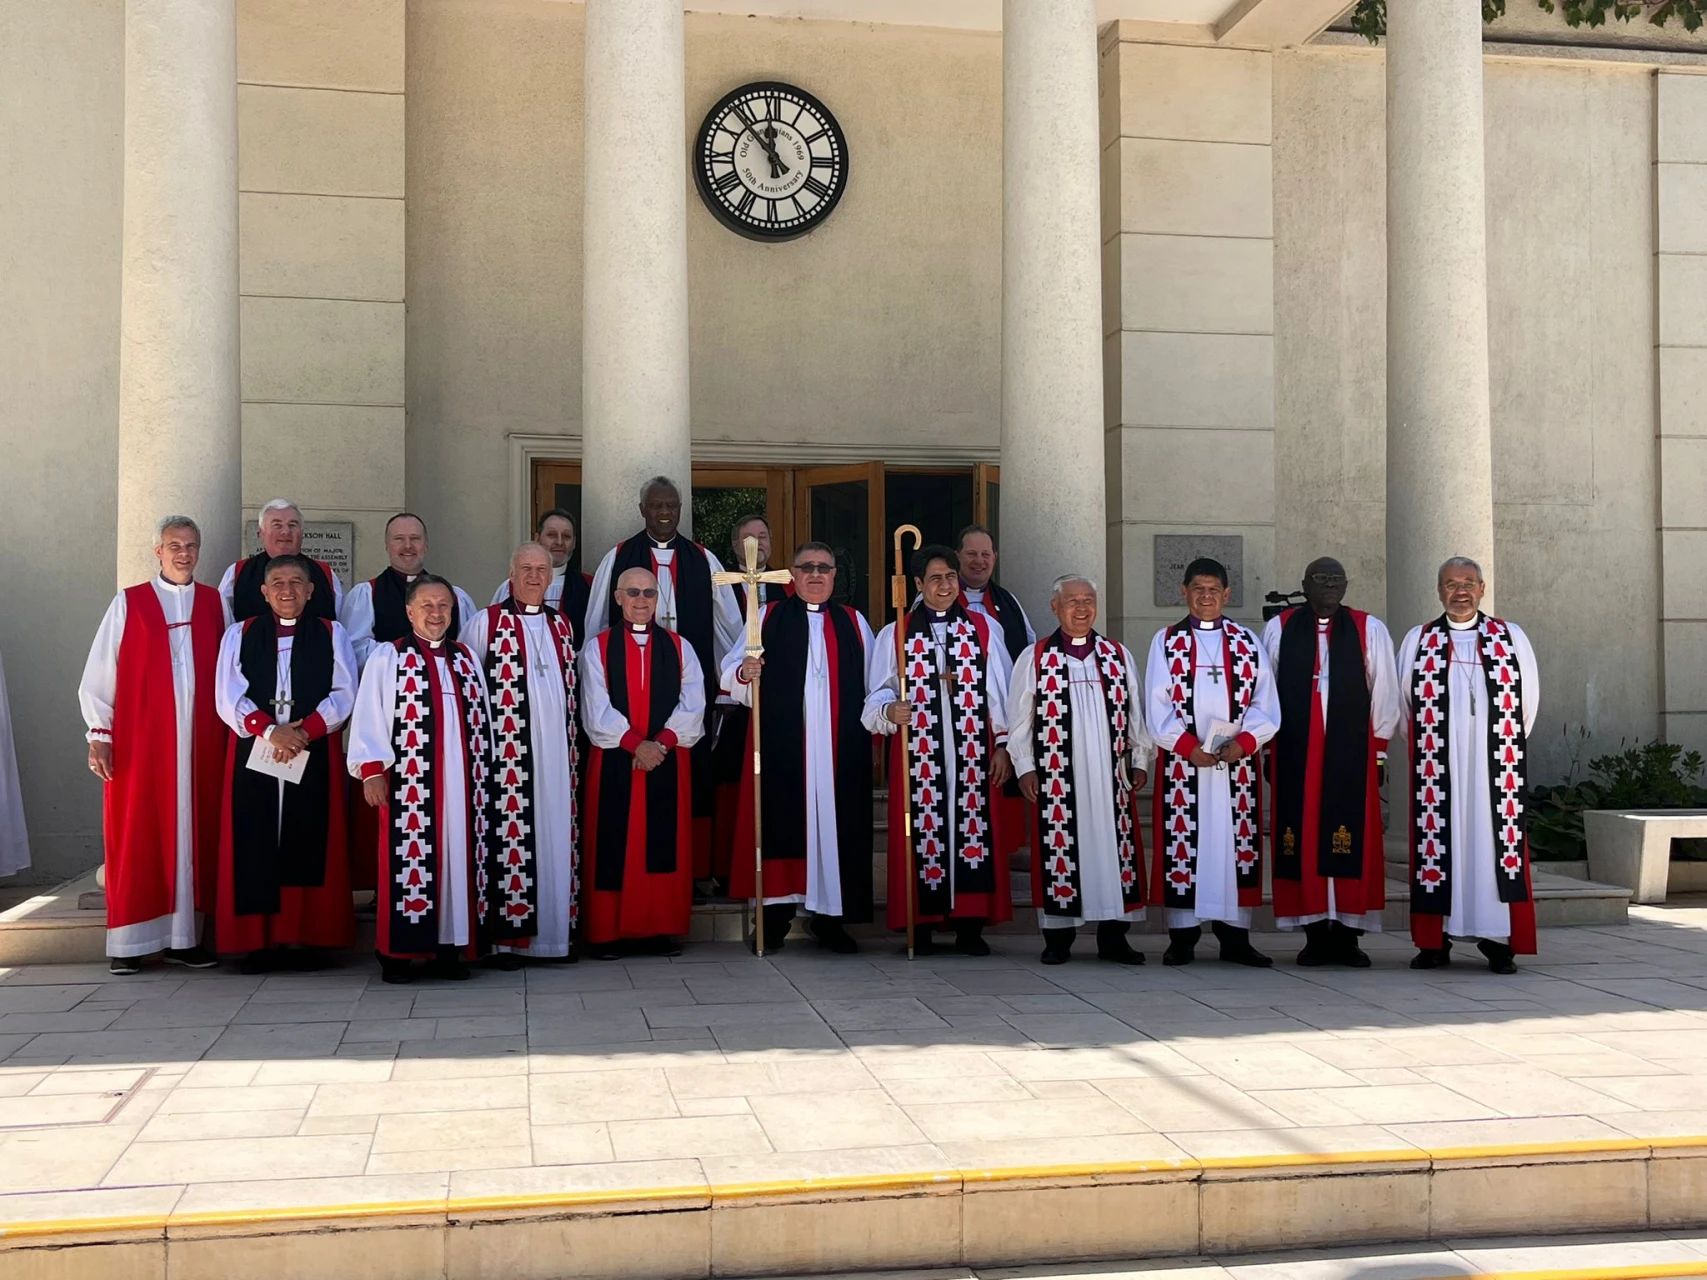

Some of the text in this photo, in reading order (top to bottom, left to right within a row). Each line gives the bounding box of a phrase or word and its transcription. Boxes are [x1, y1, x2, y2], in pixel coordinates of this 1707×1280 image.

[765, 98, 781, 121] XII
[718, 123, 740, 141] X
[805, 129, 827, 145] II
[711, 150, 734, 164] IX
[740, 142, 750, 158] Old
[792, 140, 805, 160] 1969
[811, 157, 833, 169] III
[742, 168, 804, 193] 50th Anniversary
[326, 532, 342, 540] HALL
